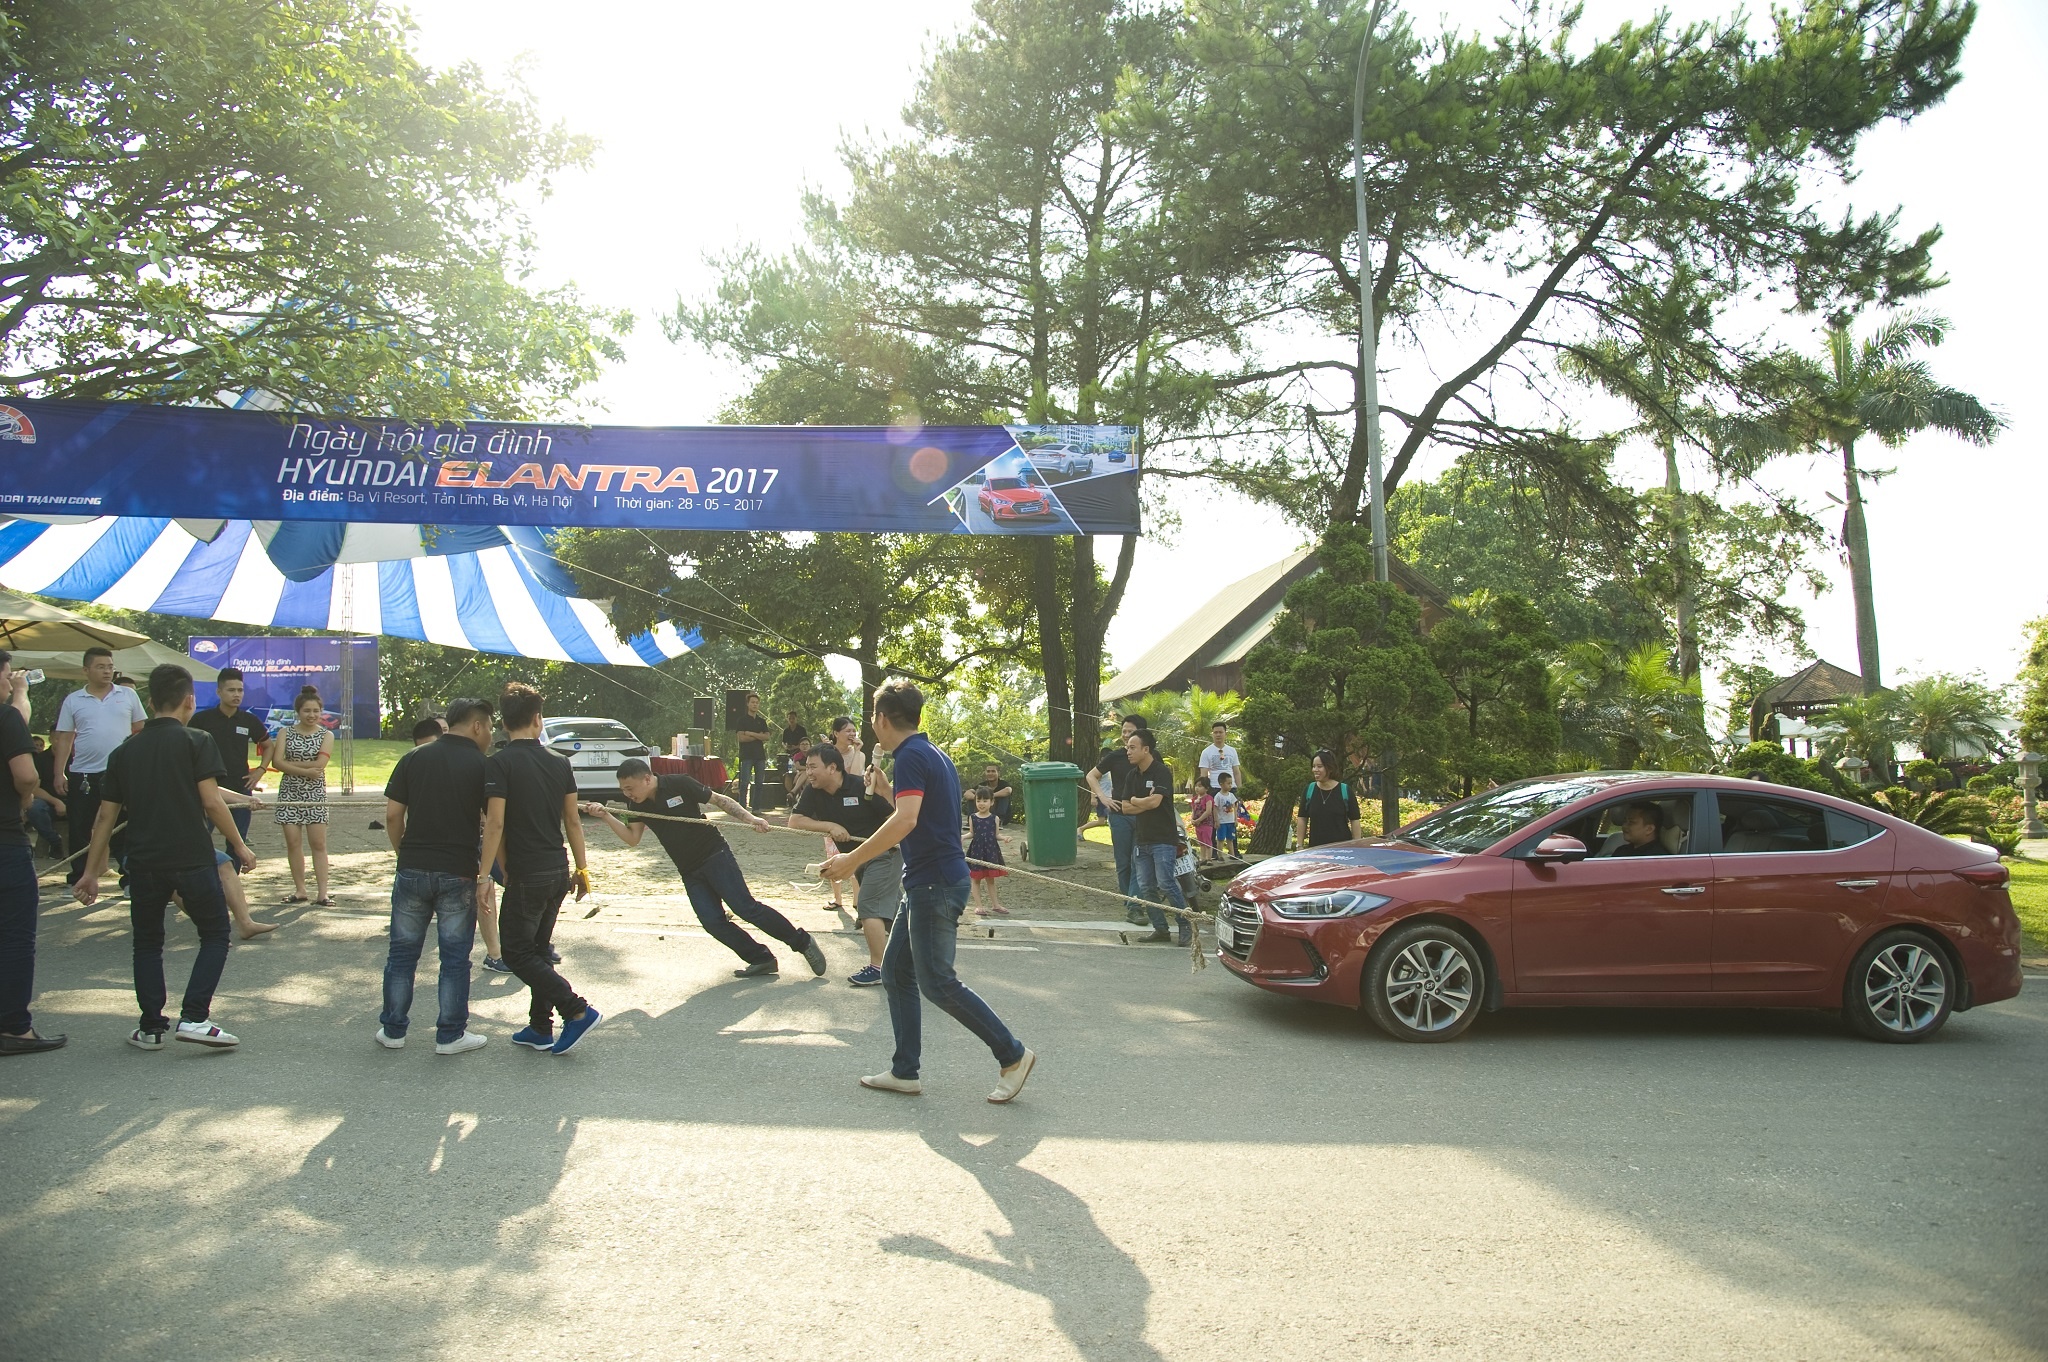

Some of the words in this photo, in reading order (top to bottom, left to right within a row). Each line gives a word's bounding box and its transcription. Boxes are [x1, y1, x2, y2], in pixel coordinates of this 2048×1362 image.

[288, 423, 368, 457] Ngày
[433, 427, 478, 459] gia
[487, 428, 552, 455] đình
[276, 457, 429, 487] HYUNDAI
[434, 460, 700, 494] ELANTRA
[706, 467, 779, 494] 2017
[282, 489, 305, 503] Địa
[308, 488, 344, 502] điểm:
[347, 490, 364, 503] Ba
[368, 490, 381, 503] Vì
[384, 491, 428, 505] Resort,
[432, 492, 456, 505] Tản
[459, 493, 489, 507] Lĩnh,
[492, 494, 509, 506] Ba
[513, 494, 528, 508] Vì,
[531, 495, 548, 507] Hà
[552, 495, 573, 509] Nội
[614, 496, 642, 509] Thời
[645, 498, 674, 512] gian:
[677, 498, 693, 510] 28
[704, 498, 720, 511] 05
[734, 499, 763, 511] 2017
[265, 665, 324, 673] ELANTRA
